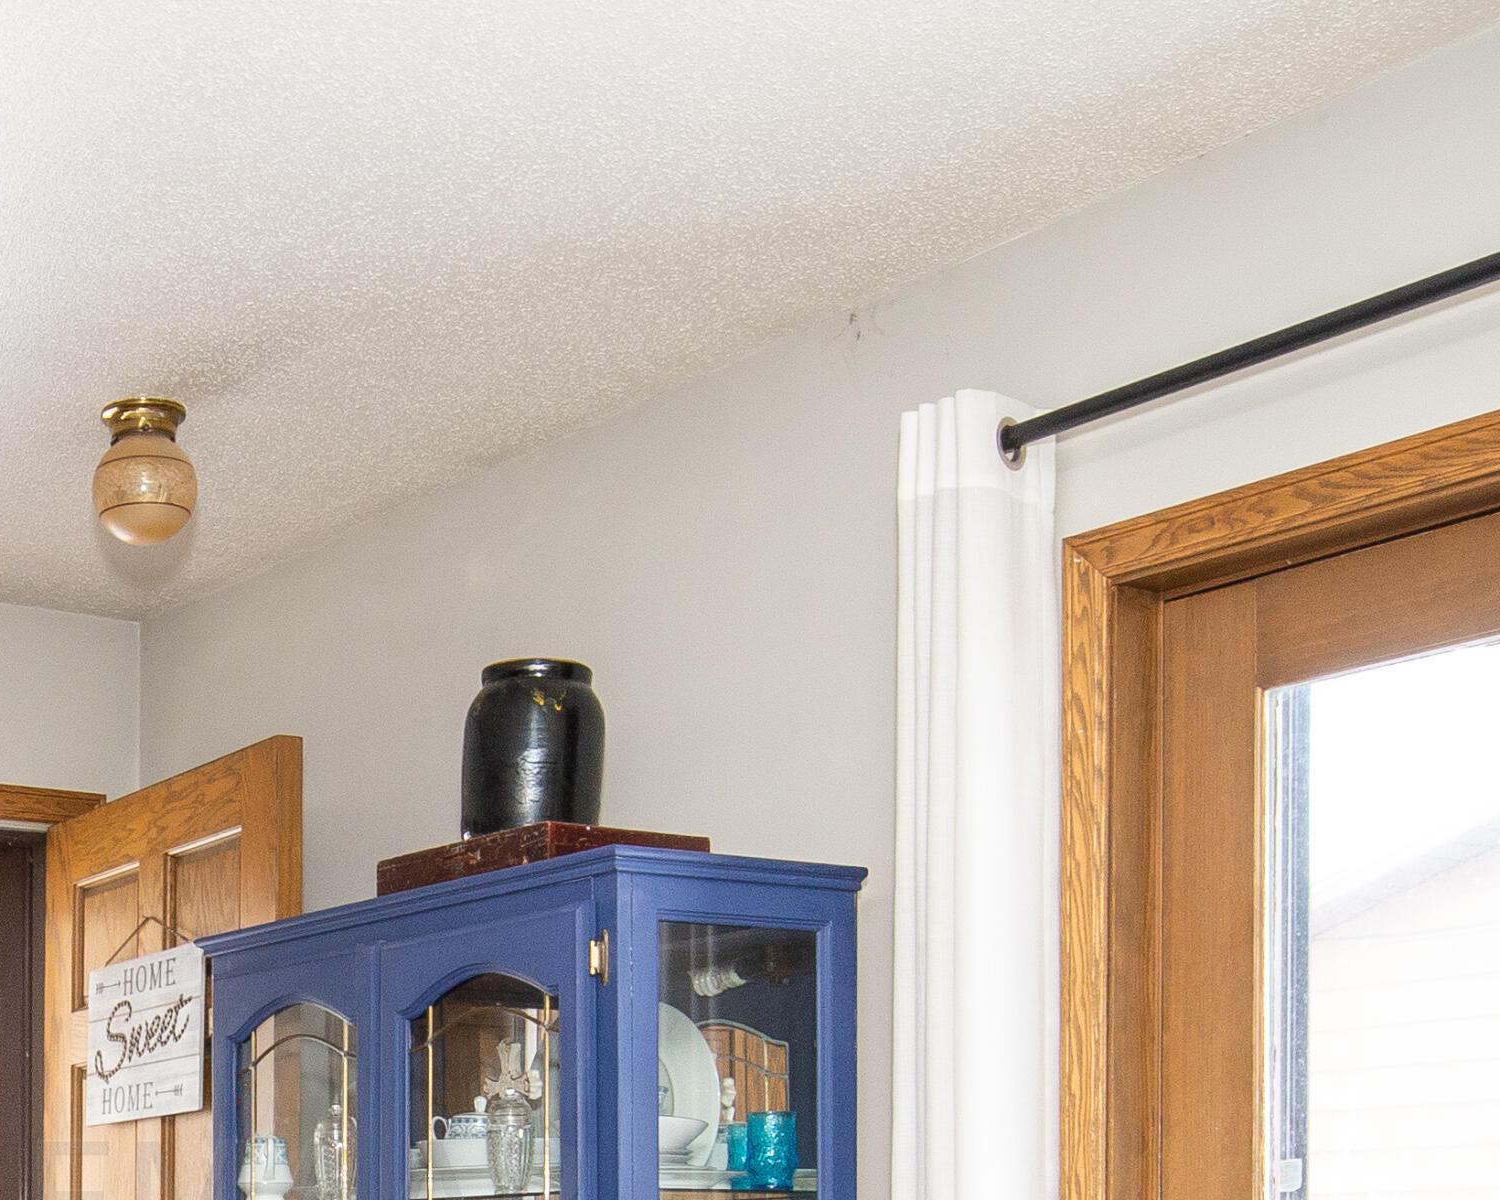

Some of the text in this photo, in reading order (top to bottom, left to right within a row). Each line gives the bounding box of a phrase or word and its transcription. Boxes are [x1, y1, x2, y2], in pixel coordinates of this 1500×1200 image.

[123, 957, 177, 996] HOME
[95, 993, 194, 1084] Sweet
[101, 1081, 154, 1115] HOME
